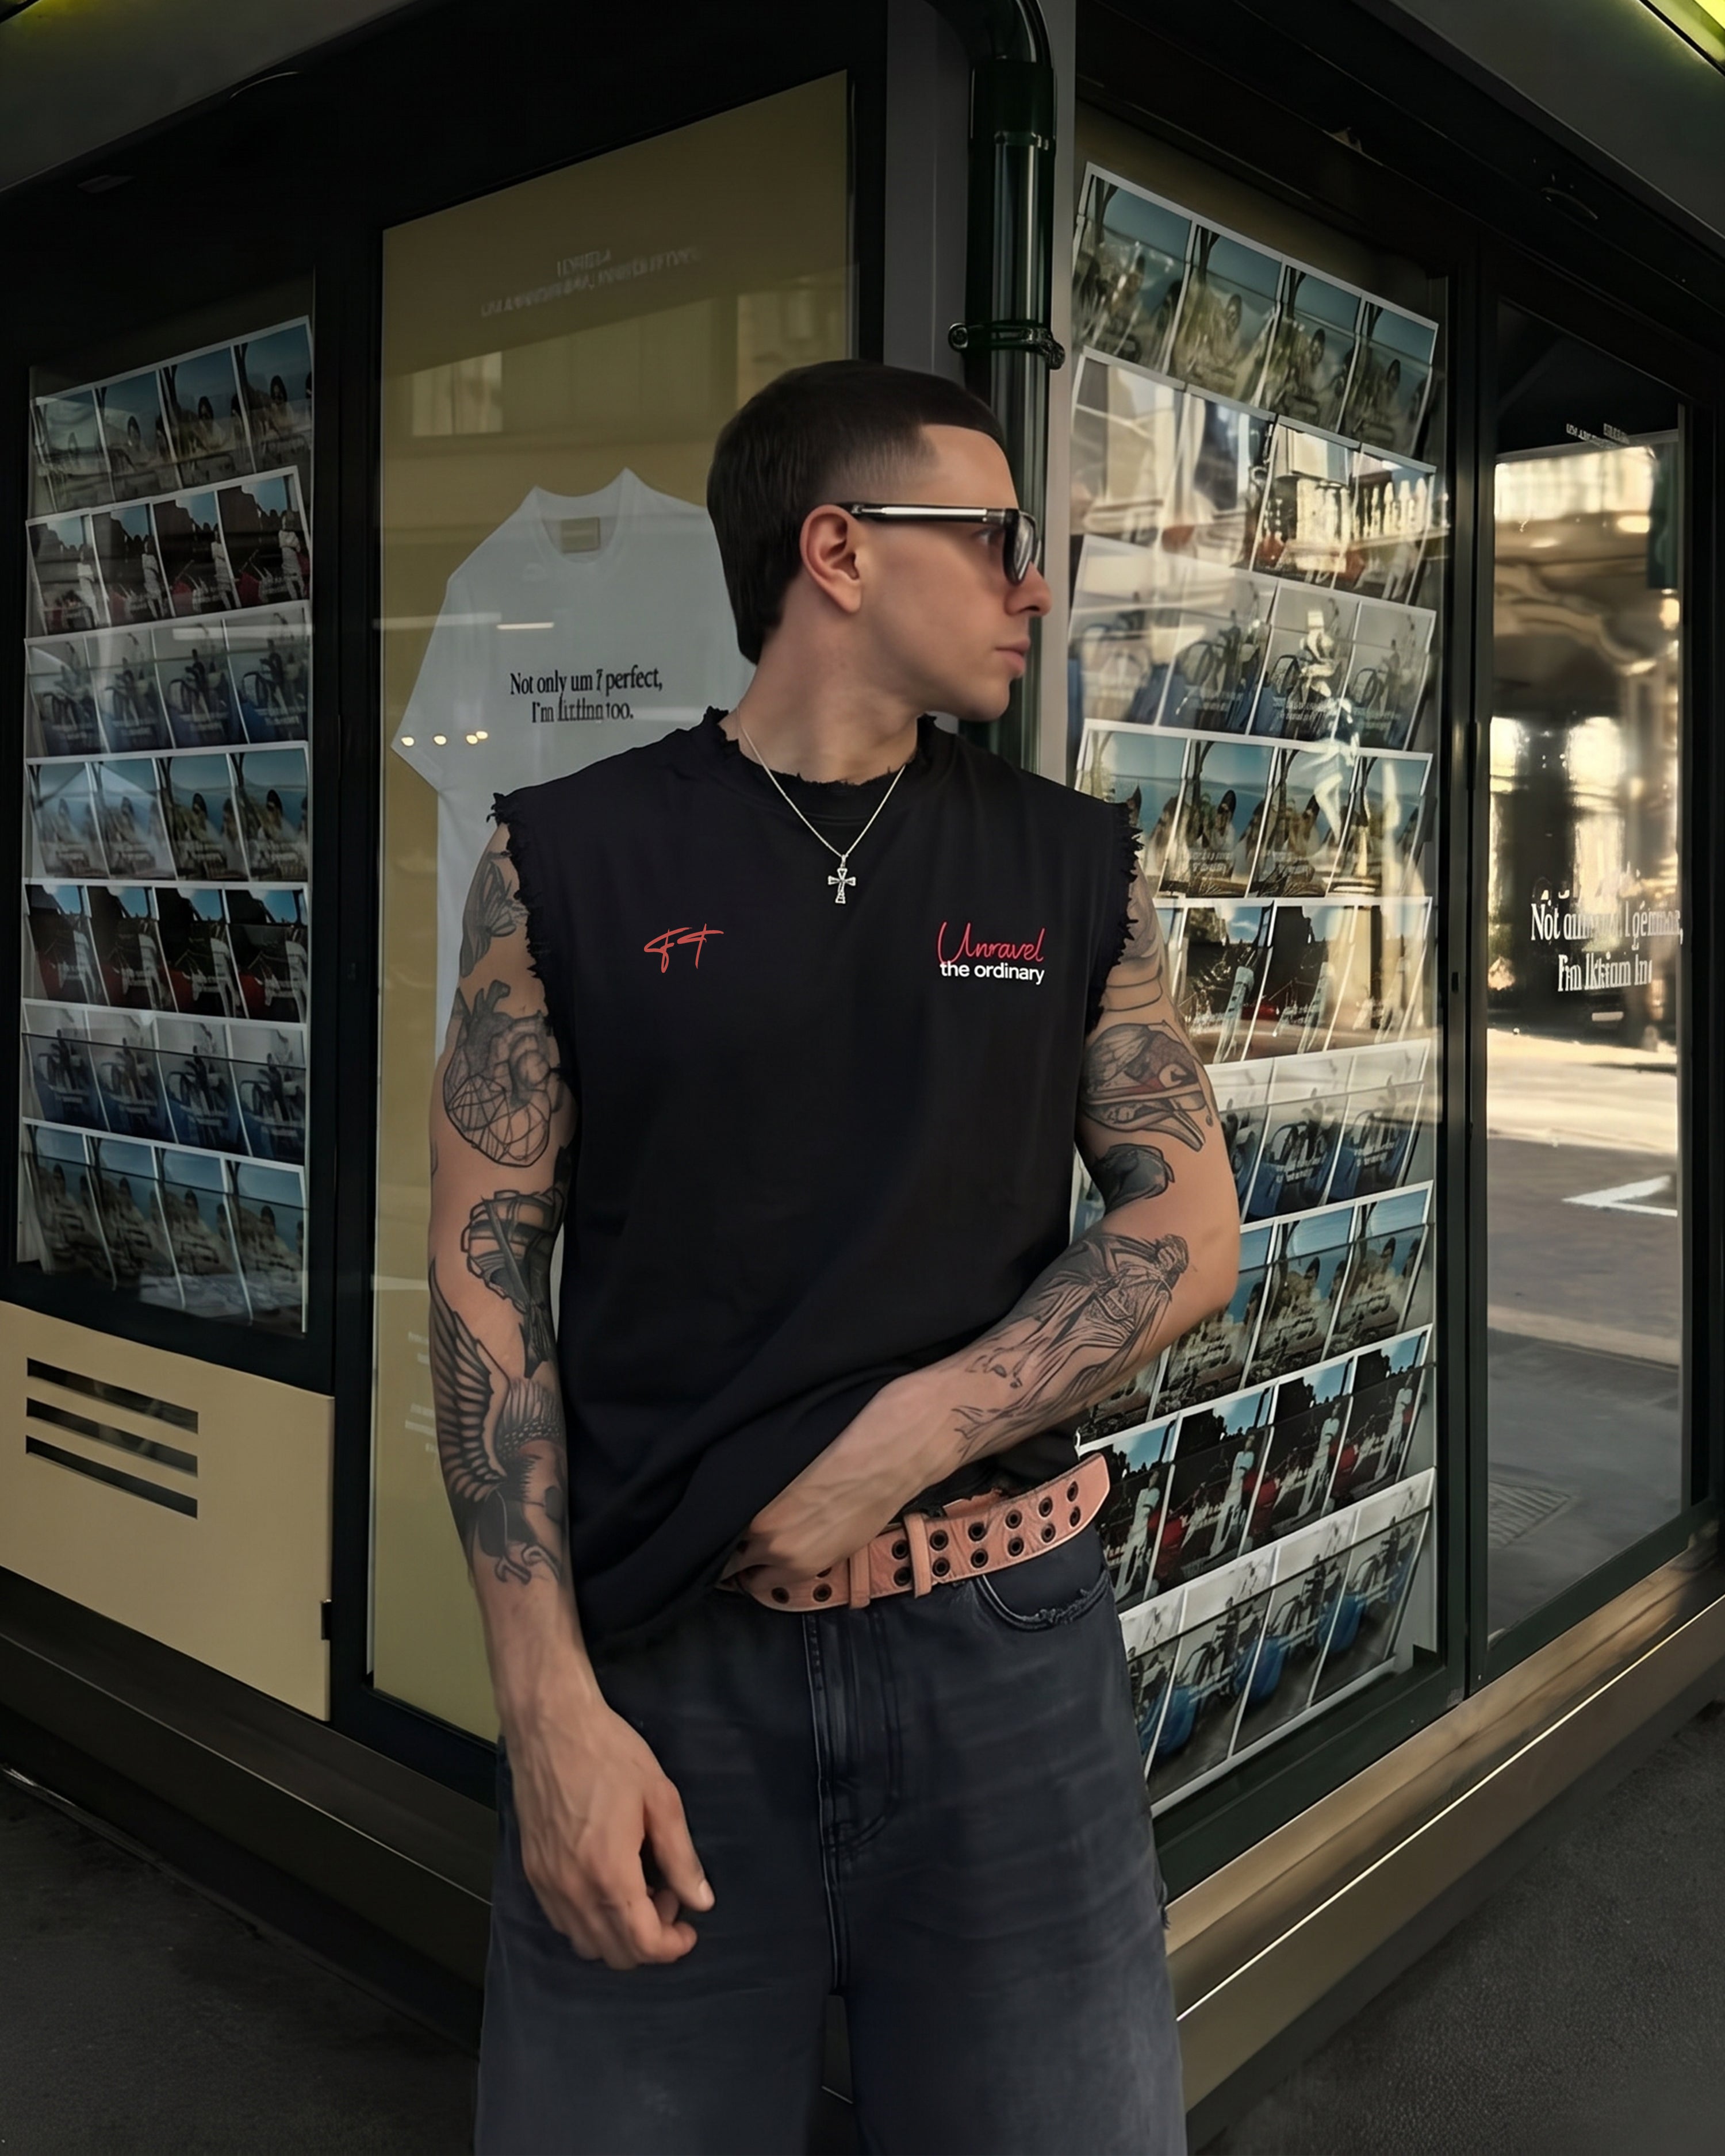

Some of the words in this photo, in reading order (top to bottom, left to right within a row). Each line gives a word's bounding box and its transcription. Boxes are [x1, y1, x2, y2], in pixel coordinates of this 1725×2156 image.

[510, 672, 534, 695] Not
[537, 669, 568, 694] only
[605, 664, 663, 697] perfect,
[937, 921, 1046, 964] Unravel
[940, 960, 970, 977] the
[973, 962, 1045, 985] ordinary
